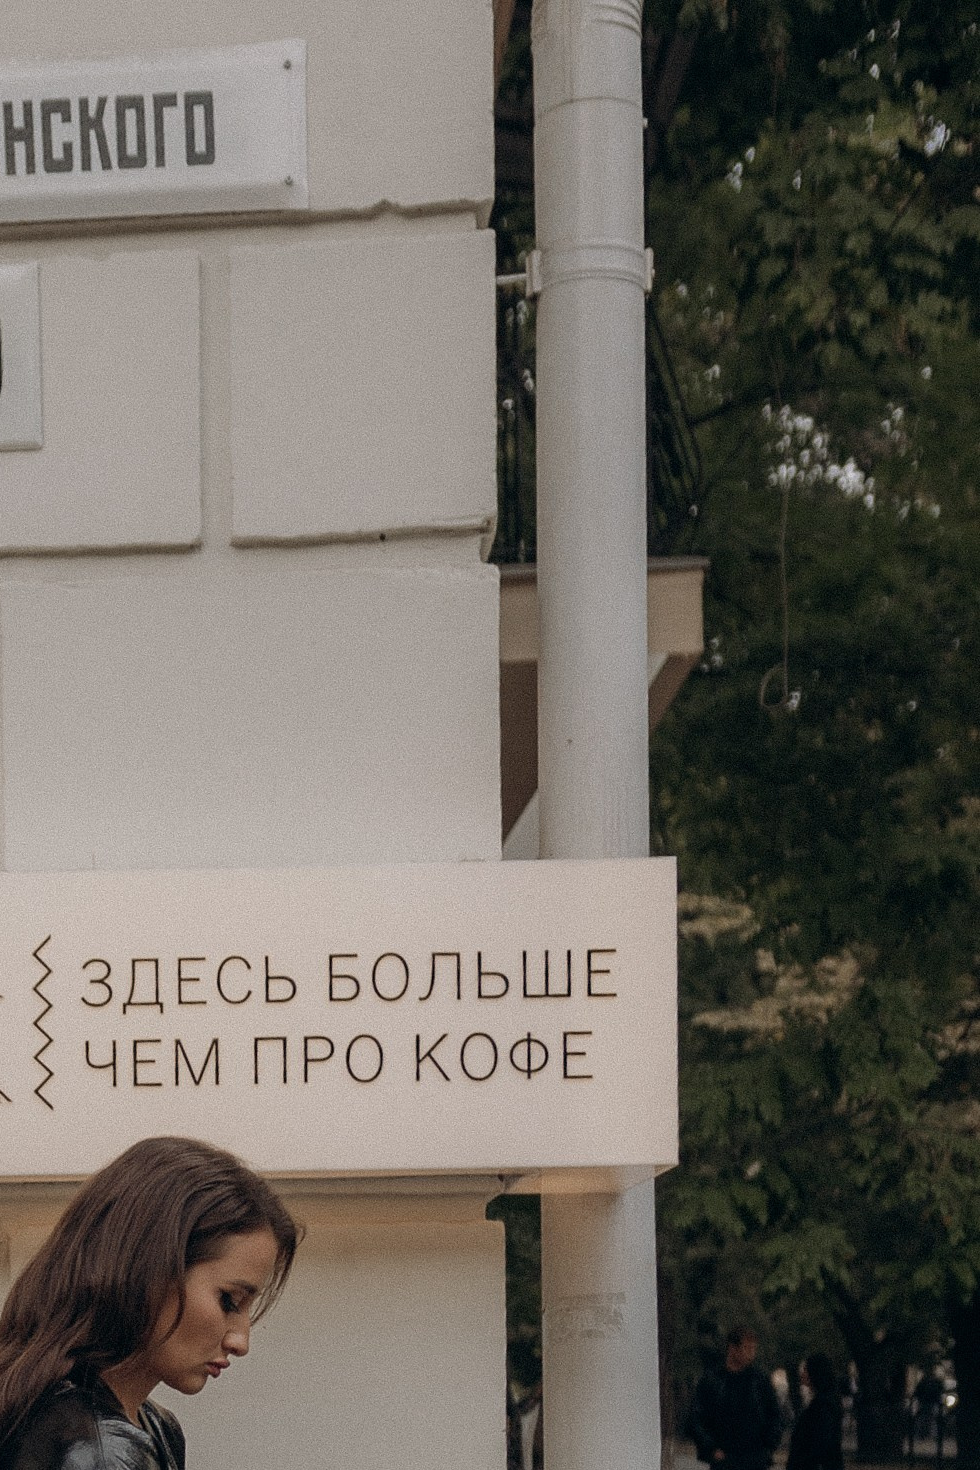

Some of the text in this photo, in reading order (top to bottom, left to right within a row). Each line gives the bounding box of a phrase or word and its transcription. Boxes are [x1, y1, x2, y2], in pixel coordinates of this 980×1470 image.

[79, 947, 619, 1017] ЗДЕСЬ БОЛЬШЕ
[83, 1030, 595, 1089] ЧЕМ ПРО КОФЕ
